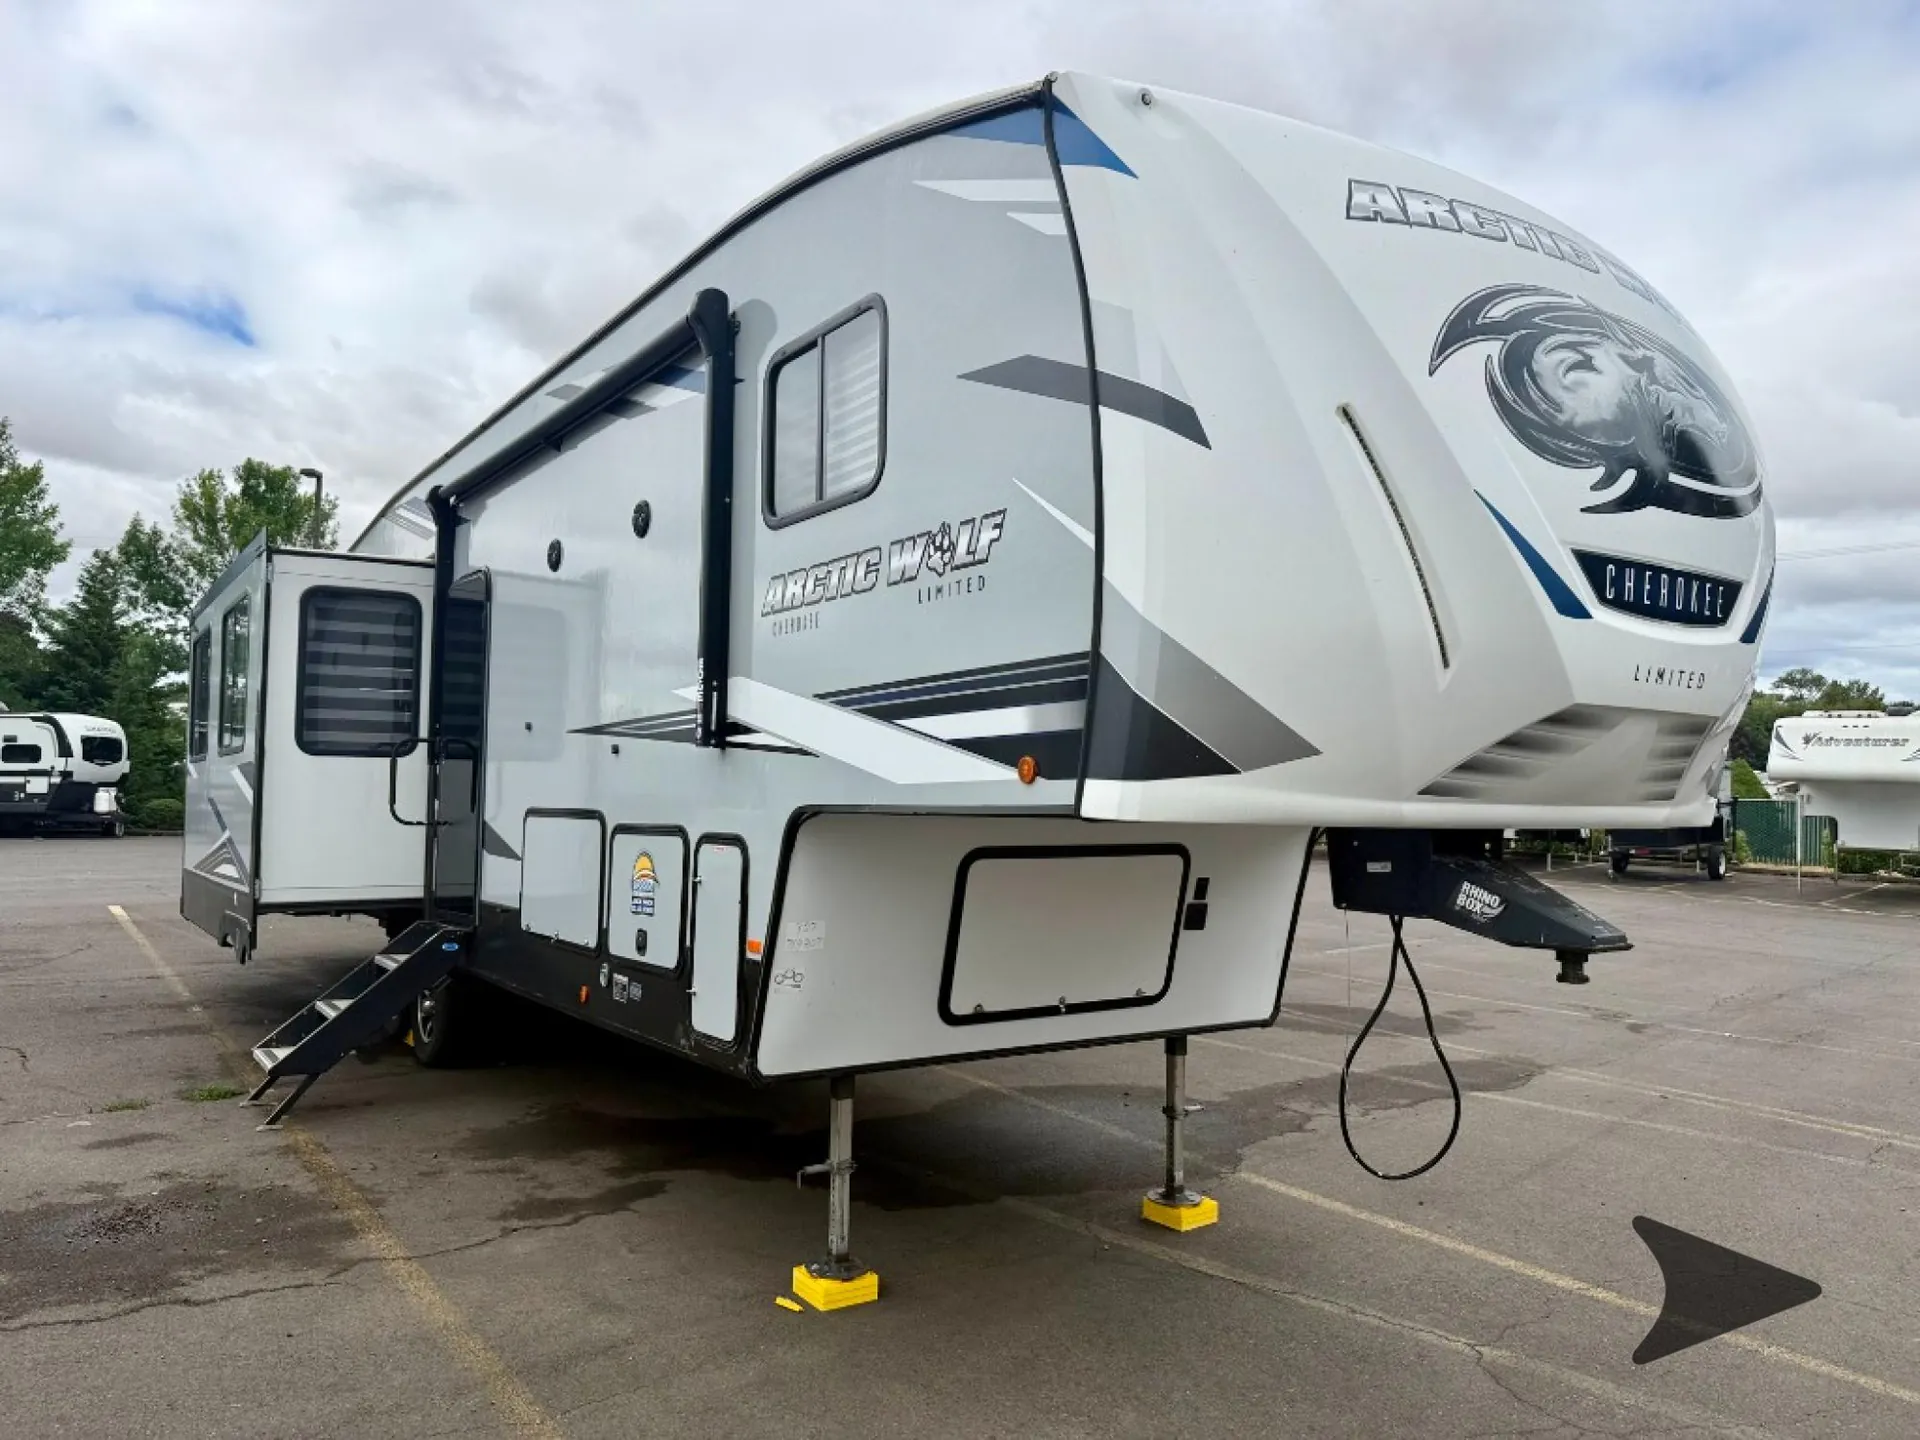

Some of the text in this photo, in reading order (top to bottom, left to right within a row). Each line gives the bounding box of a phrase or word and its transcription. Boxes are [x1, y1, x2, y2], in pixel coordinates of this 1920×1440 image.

[1346, 178, 1600, 274] ARCTIC
[761, 508, 1007, 618] ARCTIC WOLF
[918, 575, 986, 604] LIMITED
[1606, 564, 1725, 619] CHEROKEE
[1634, 664, 1706, 689] LIMITED
[1456, 893, 1484, 914] BOX
[1460, 880, 1501, 908] RHINO
